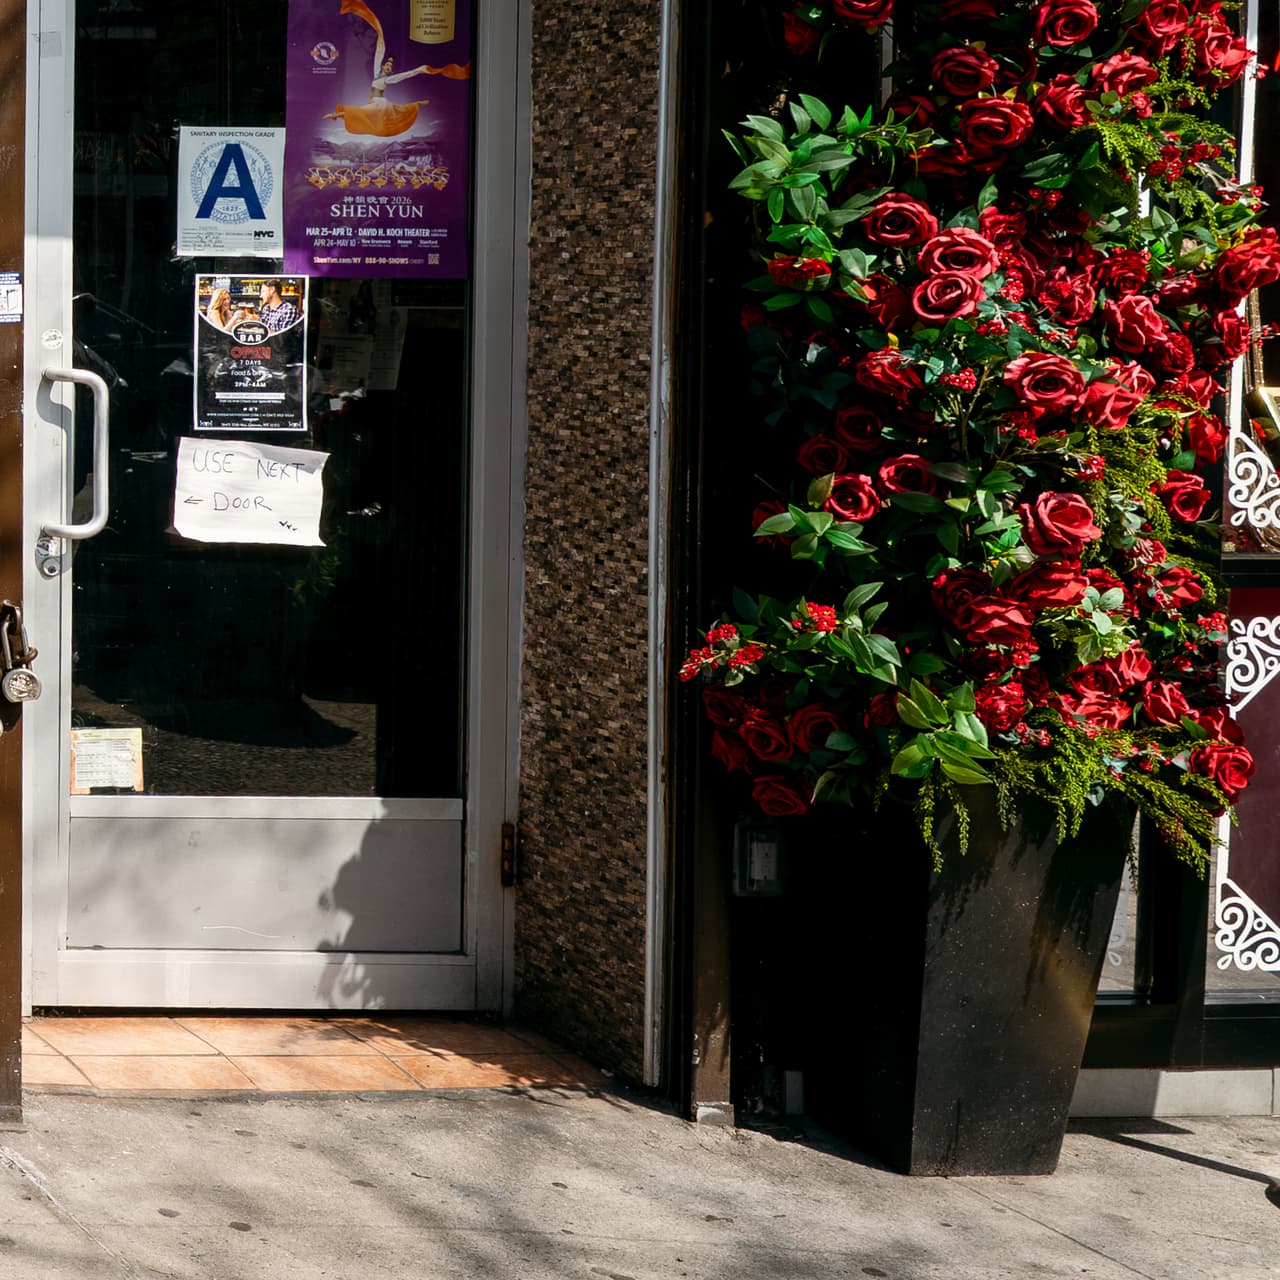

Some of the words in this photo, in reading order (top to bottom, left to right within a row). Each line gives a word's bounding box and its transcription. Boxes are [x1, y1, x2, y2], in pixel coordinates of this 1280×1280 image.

[195, 143, 266, 220] A
[391, 196, 412, 204] 2026
[330, 204, 380, 217] SHEN
[385, 204, 424, 218] YUN
[253, 230, 274, 238] NYC
[306, 228, 320, 236] MAR
[358, 228, 377, 236] DAVID
[386, 228, 403, 236] KOCH
[404, 228, 430, 237] THEATER
[240, 334, 262, 342] BAR
[192, 448, 234, 473] USE
[257, 459, 305, 482] NEXT
[213, 492, 272, 511] DOOR
